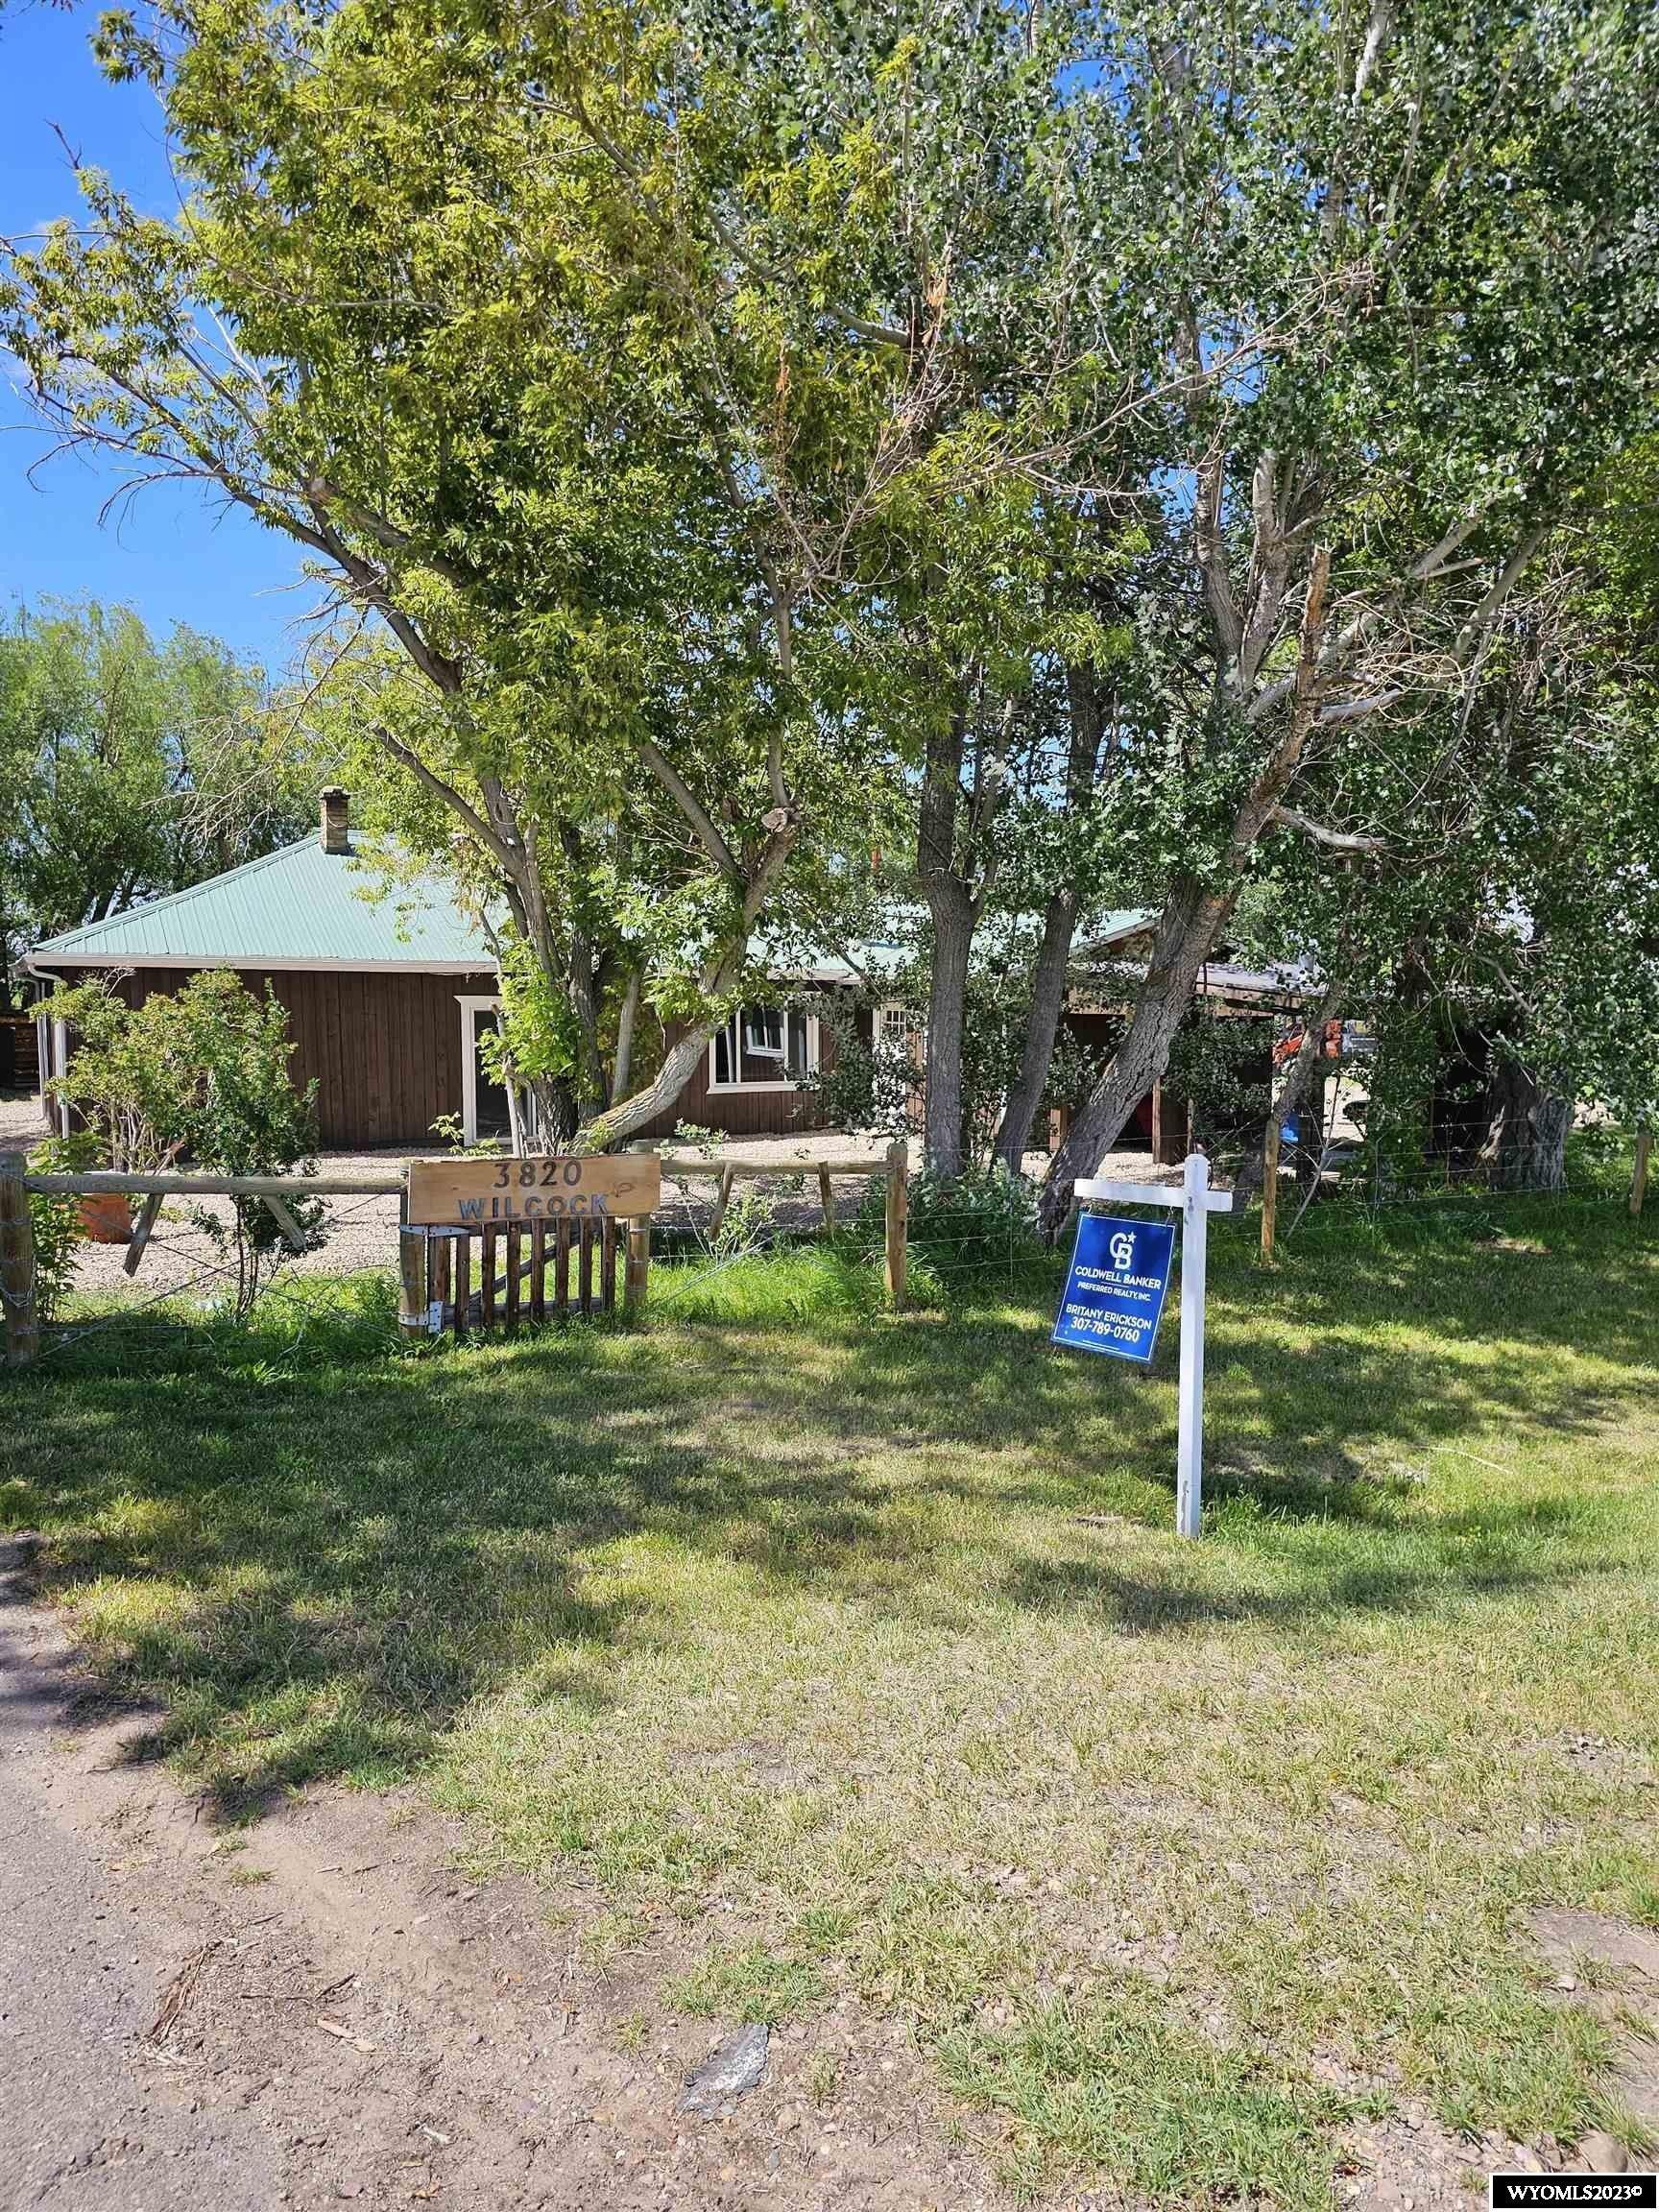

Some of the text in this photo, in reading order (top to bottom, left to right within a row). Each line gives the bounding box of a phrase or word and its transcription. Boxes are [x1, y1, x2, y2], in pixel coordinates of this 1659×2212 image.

[492, 1160, 582, 1189] 3820
[457, 1193, 610, 1220] WILCOCK
[1075, 1265, 1162, 1289] COLDWELL BANKER
[1077, 1281, 1113, 1295] PREFERRED
[1066, 1303, 1152, 1330] BRITANY ERICKSON
[1070, 1315, 1140, 1343] 307-789-0760
